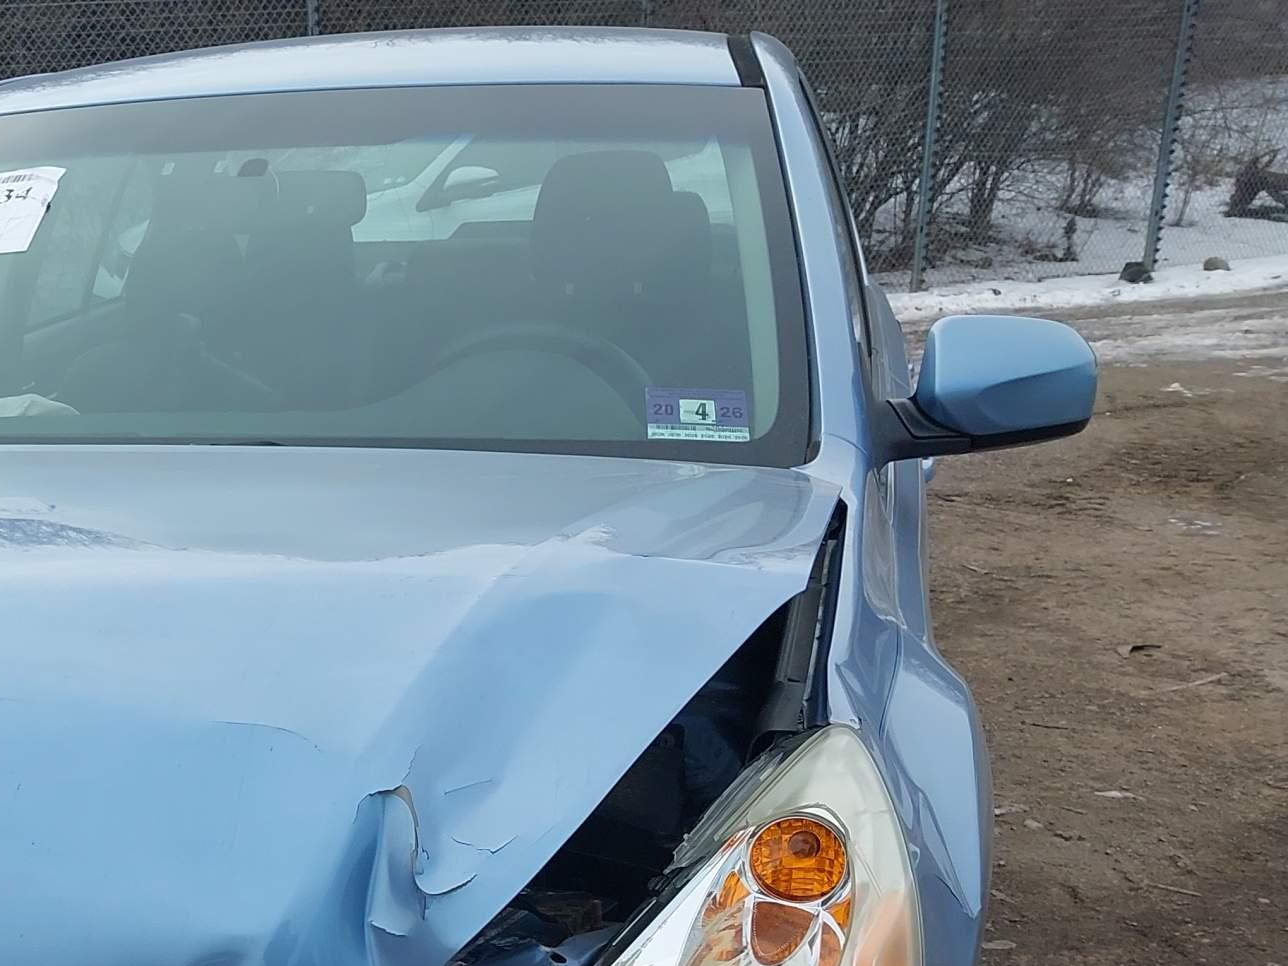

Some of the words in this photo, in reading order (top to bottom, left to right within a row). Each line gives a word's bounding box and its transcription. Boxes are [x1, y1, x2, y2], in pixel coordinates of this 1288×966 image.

[653, 403, 674, 416] 20
[695, 402, 710, 421] 4
[720, 406, 743, 419] 26
